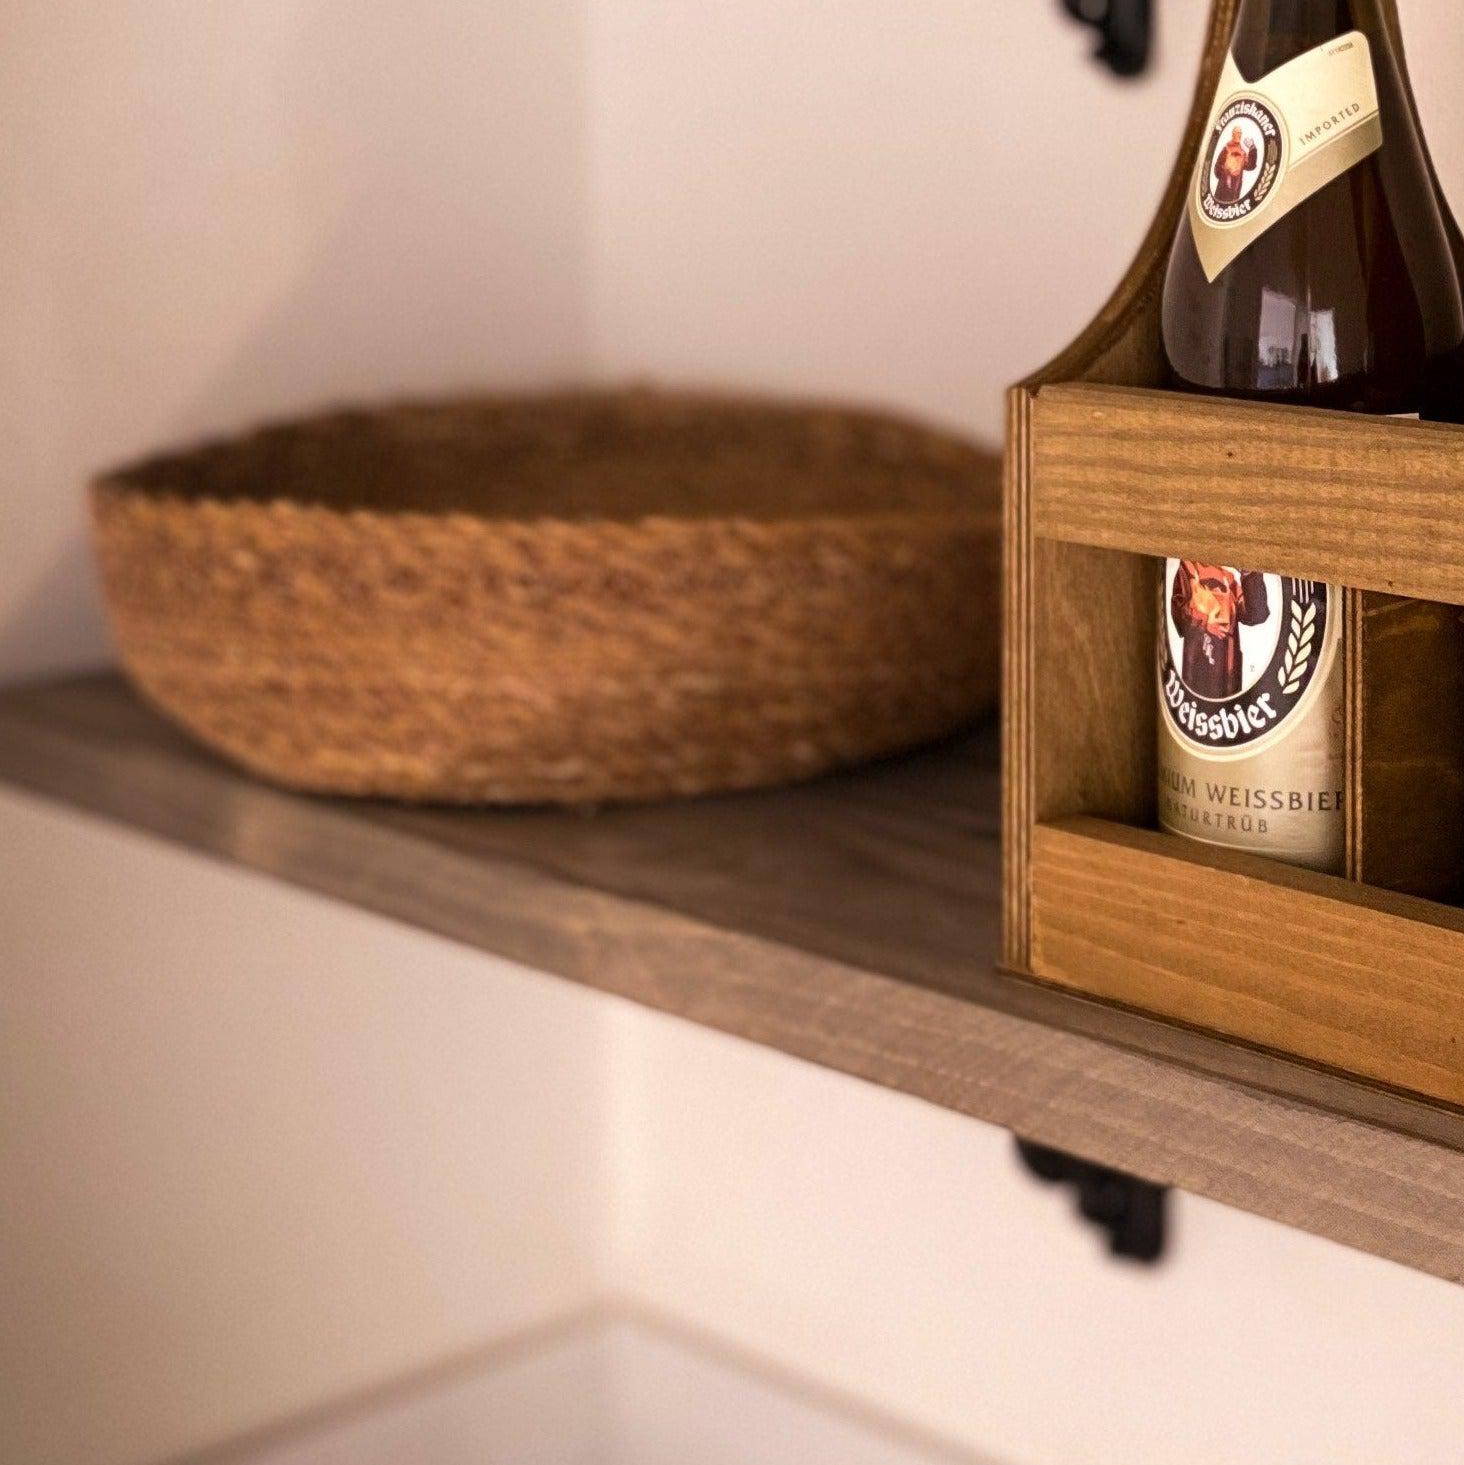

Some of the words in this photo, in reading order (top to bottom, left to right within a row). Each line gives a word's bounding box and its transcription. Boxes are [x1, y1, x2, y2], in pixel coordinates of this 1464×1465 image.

[1299, 102, 1361, 146] IMPORTED
[1203, 192, 1252, 220] Weissbier
[1165, 668, 1278, 741] Weissbier
